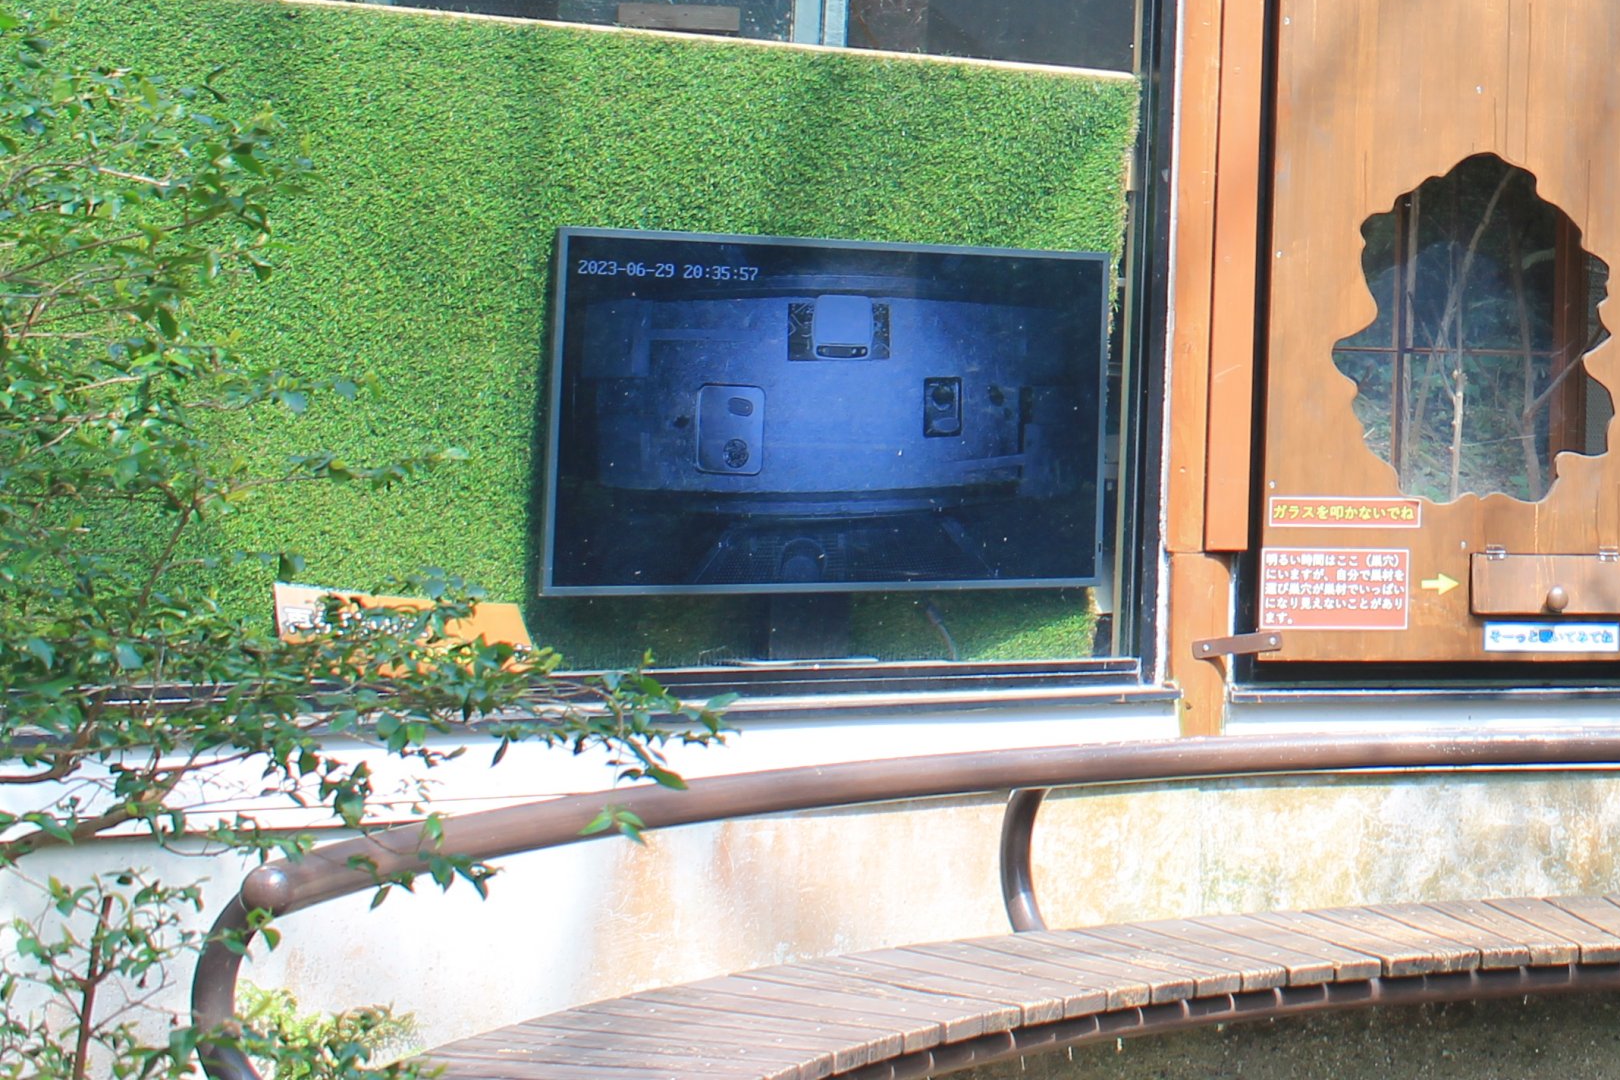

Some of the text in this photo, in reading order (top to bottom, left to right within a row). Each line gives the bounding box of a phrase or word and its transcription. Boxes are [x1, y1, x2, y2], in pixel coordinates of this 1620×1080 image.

[577, 259, 759, 281] 2023-06-29 20:35:57
[1273, 504, 1415, 520] ガラスを叩かないでね
[1265, 597, 1403, 610] になり見えないことがあり
[1265, 611, 1294, 624] ます。
